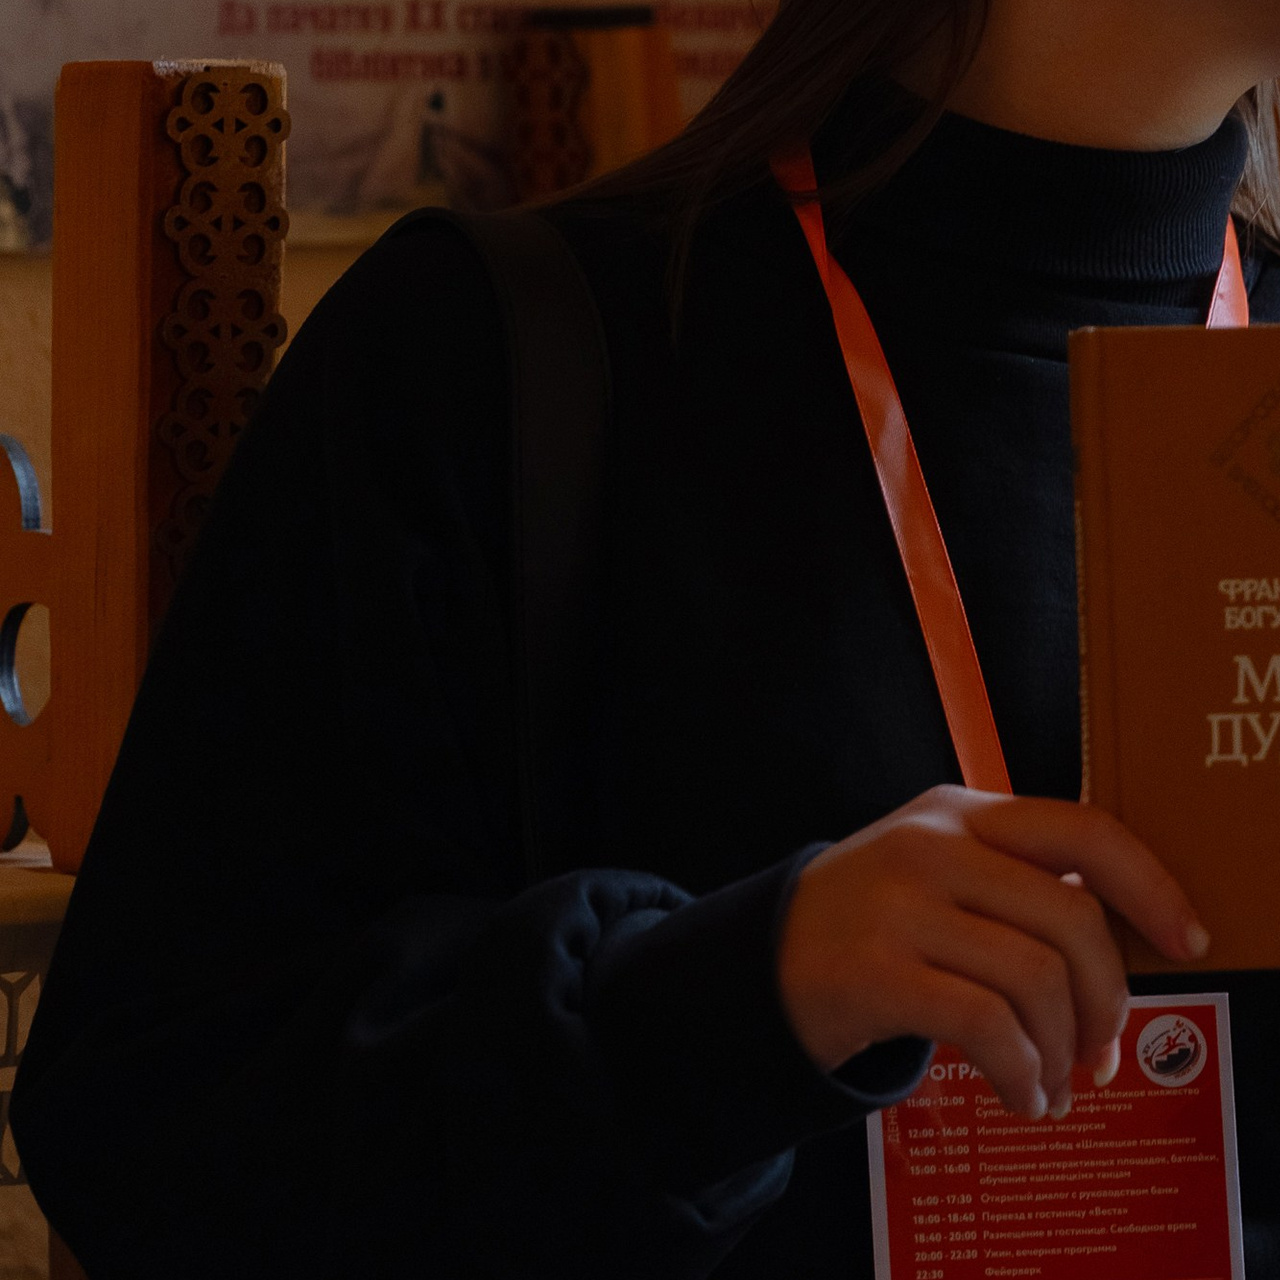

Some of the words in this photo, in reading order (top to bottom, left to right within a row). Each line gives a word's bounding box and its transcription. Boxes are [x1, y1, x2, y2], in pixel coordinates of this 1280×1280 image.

[1072, 1090, 1095, 1101] узей
[1098, 1089, 1146, 1099] «Великое
[1147, 1088, 1200, 1097] княжество
[907, 1097, 932, 1108] 11:00
[938, 1095, 965, 1106] 12:00
[1076, 1103, 1132, 1113] кофе-пауза
[908, 1128, 934, 1138] 12:00
[941, 1126, 969, 1137] 14:00
[977, 1125, 1053, 1136] Интерактивная
[1056, 1123, 1106, 1133] экскурсия
[909, 1146, 936, 1157] 14:00
[943, 1144, 970, 1155] 15:00
[978, 1142, 1047, 1154] Комплексный
[1049, 1141, 1073, 1151] обед
[910, 1164, 936, 1175] 15:00
[944, 1163, 970, 1174] 16:00
[979, 1162, 1037, 1172] Посещение
[1039, 1159, 1114, 1170] интерактивных
[980, 1175, 1027, 1186] обучение
[912, 1195, 939, 1206] 16:00
[946, 1193, 972, 1205] 17:30
[980, 1193, 1033, 1203] Открытый
[1035, 1192, 1069, 1201] диалог
[1079, 1188, 1149, 1200] руководством
[1150, 1186, 1179, 1195] банка
[913, 1214, 940, 1225] 18:00
[948, 1212, 975, 1223] 18:40
[982, 1211, 1026, 1222] Переезд
[1035, 1210, 1086, 1219] гостиницу
[1089, 1206, 1128, 1216] «Веста»
[914, 1232, 942, 1244] 18:40
[949, 1230, 977, 1242] 20:00
[983, 1230, 1045, 1240] Размещение
[1110, 1223, 1165, 1234] Свободное
[1167, 1223, 1197, 1232] время
[915, 1251, 943, 1262] 20:00
[950, 1249, 978, 1260] 22:30
[984, 1249, 1014, 1258] Ужин,
[1016, 1247, 1062, 1257] вечерняя
[1064, 1245, 1117, 1255] программа
[916, 1269, 944, 1280] 22:30
[985, 1266, 1041, 1277] Фейерверк
